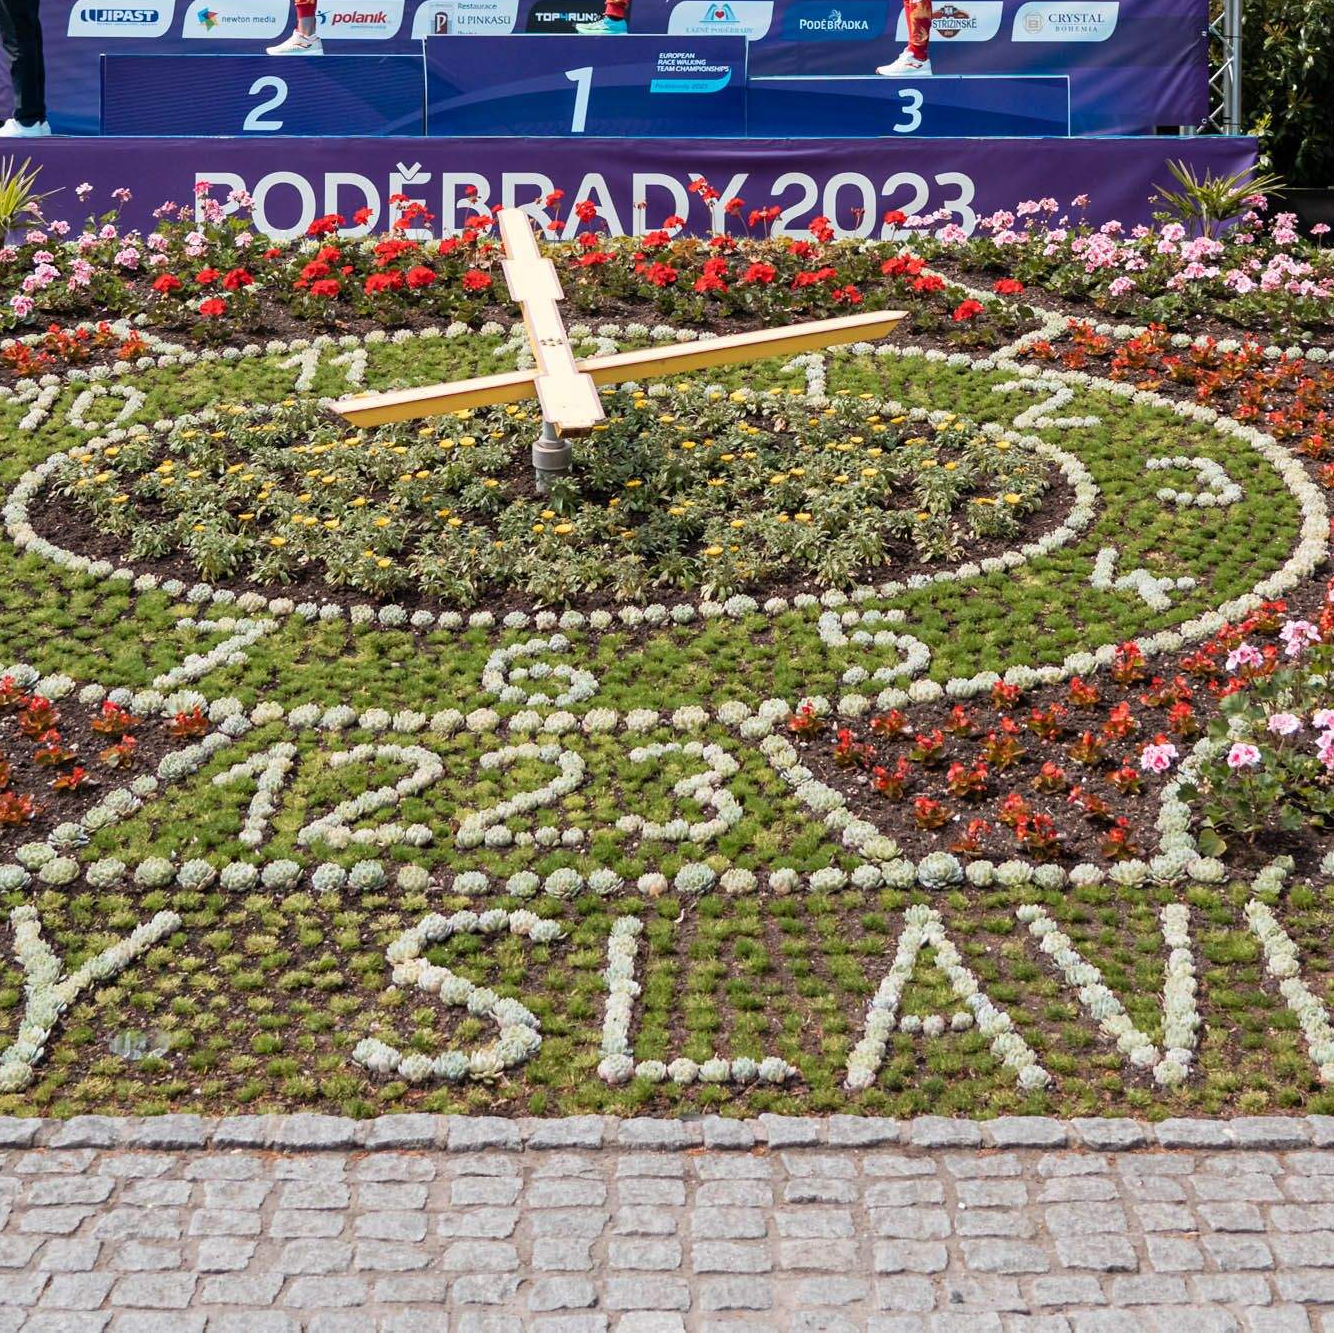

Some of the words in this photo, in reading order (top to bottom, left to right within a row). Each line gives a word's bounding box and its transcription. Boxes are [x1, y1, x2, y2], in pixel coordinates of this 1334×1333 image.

[99, 10, 154, 22] JIPAST
[222, 14, 251, 24] newton
[253, 14, 276, 24] media
[331, 11, 387, 26] polanik
[458, 16, 464, 24] U
[535, 12, 594, 21] TOP4RUN
[1048, 12, 1105, 24] CRYSTAL
[243, 75, 289, 131] 2
[565, 66, 594, 132] 1
[892, 88, 924, 133] 3
[195, 161, 749, 243] PODĚBRADY
[770, 172, 976, 243] 2023
[17, 374, 147, 431] 10
[990, 377, 1102, 430] 2
[1145, 455, 1244, 508] 3
[1091, 546, 1197, 612] 4
[152, 615, 278, 689] 7
[481, 632, 599, 706] 6
[817, 609, 932, 685] 5
[212, 741, 744, 850] 1223
